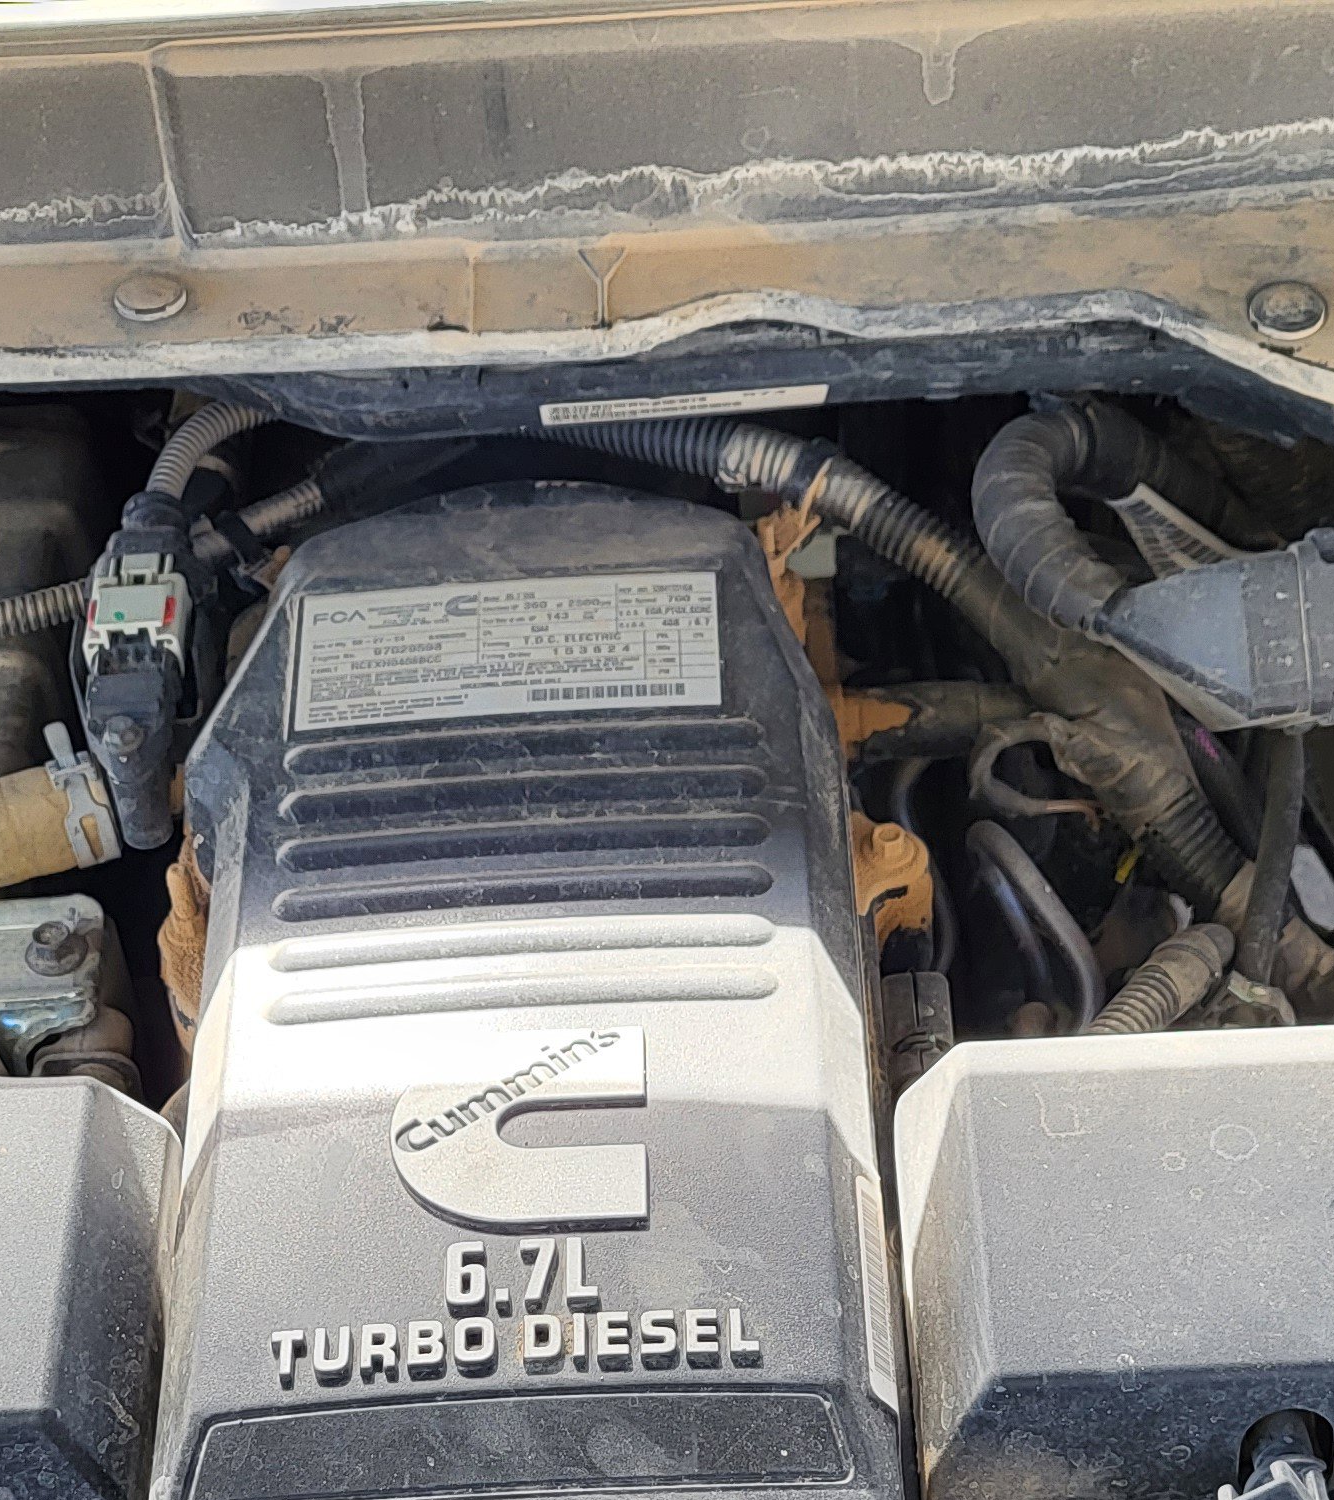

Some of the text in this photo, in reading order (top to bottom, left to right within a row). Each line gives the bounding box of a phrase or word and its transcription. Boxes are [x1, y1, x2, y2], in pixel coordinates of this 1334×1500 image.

[312, 610, 366, 626] FCA
[547, 611, 569, 622] 143
[564, 631, 622, 644] ELECTRIC
[445, 1237, 601, 1312] 6.7L
[271, 1308, 761, 1385] TURBO DIESEL
